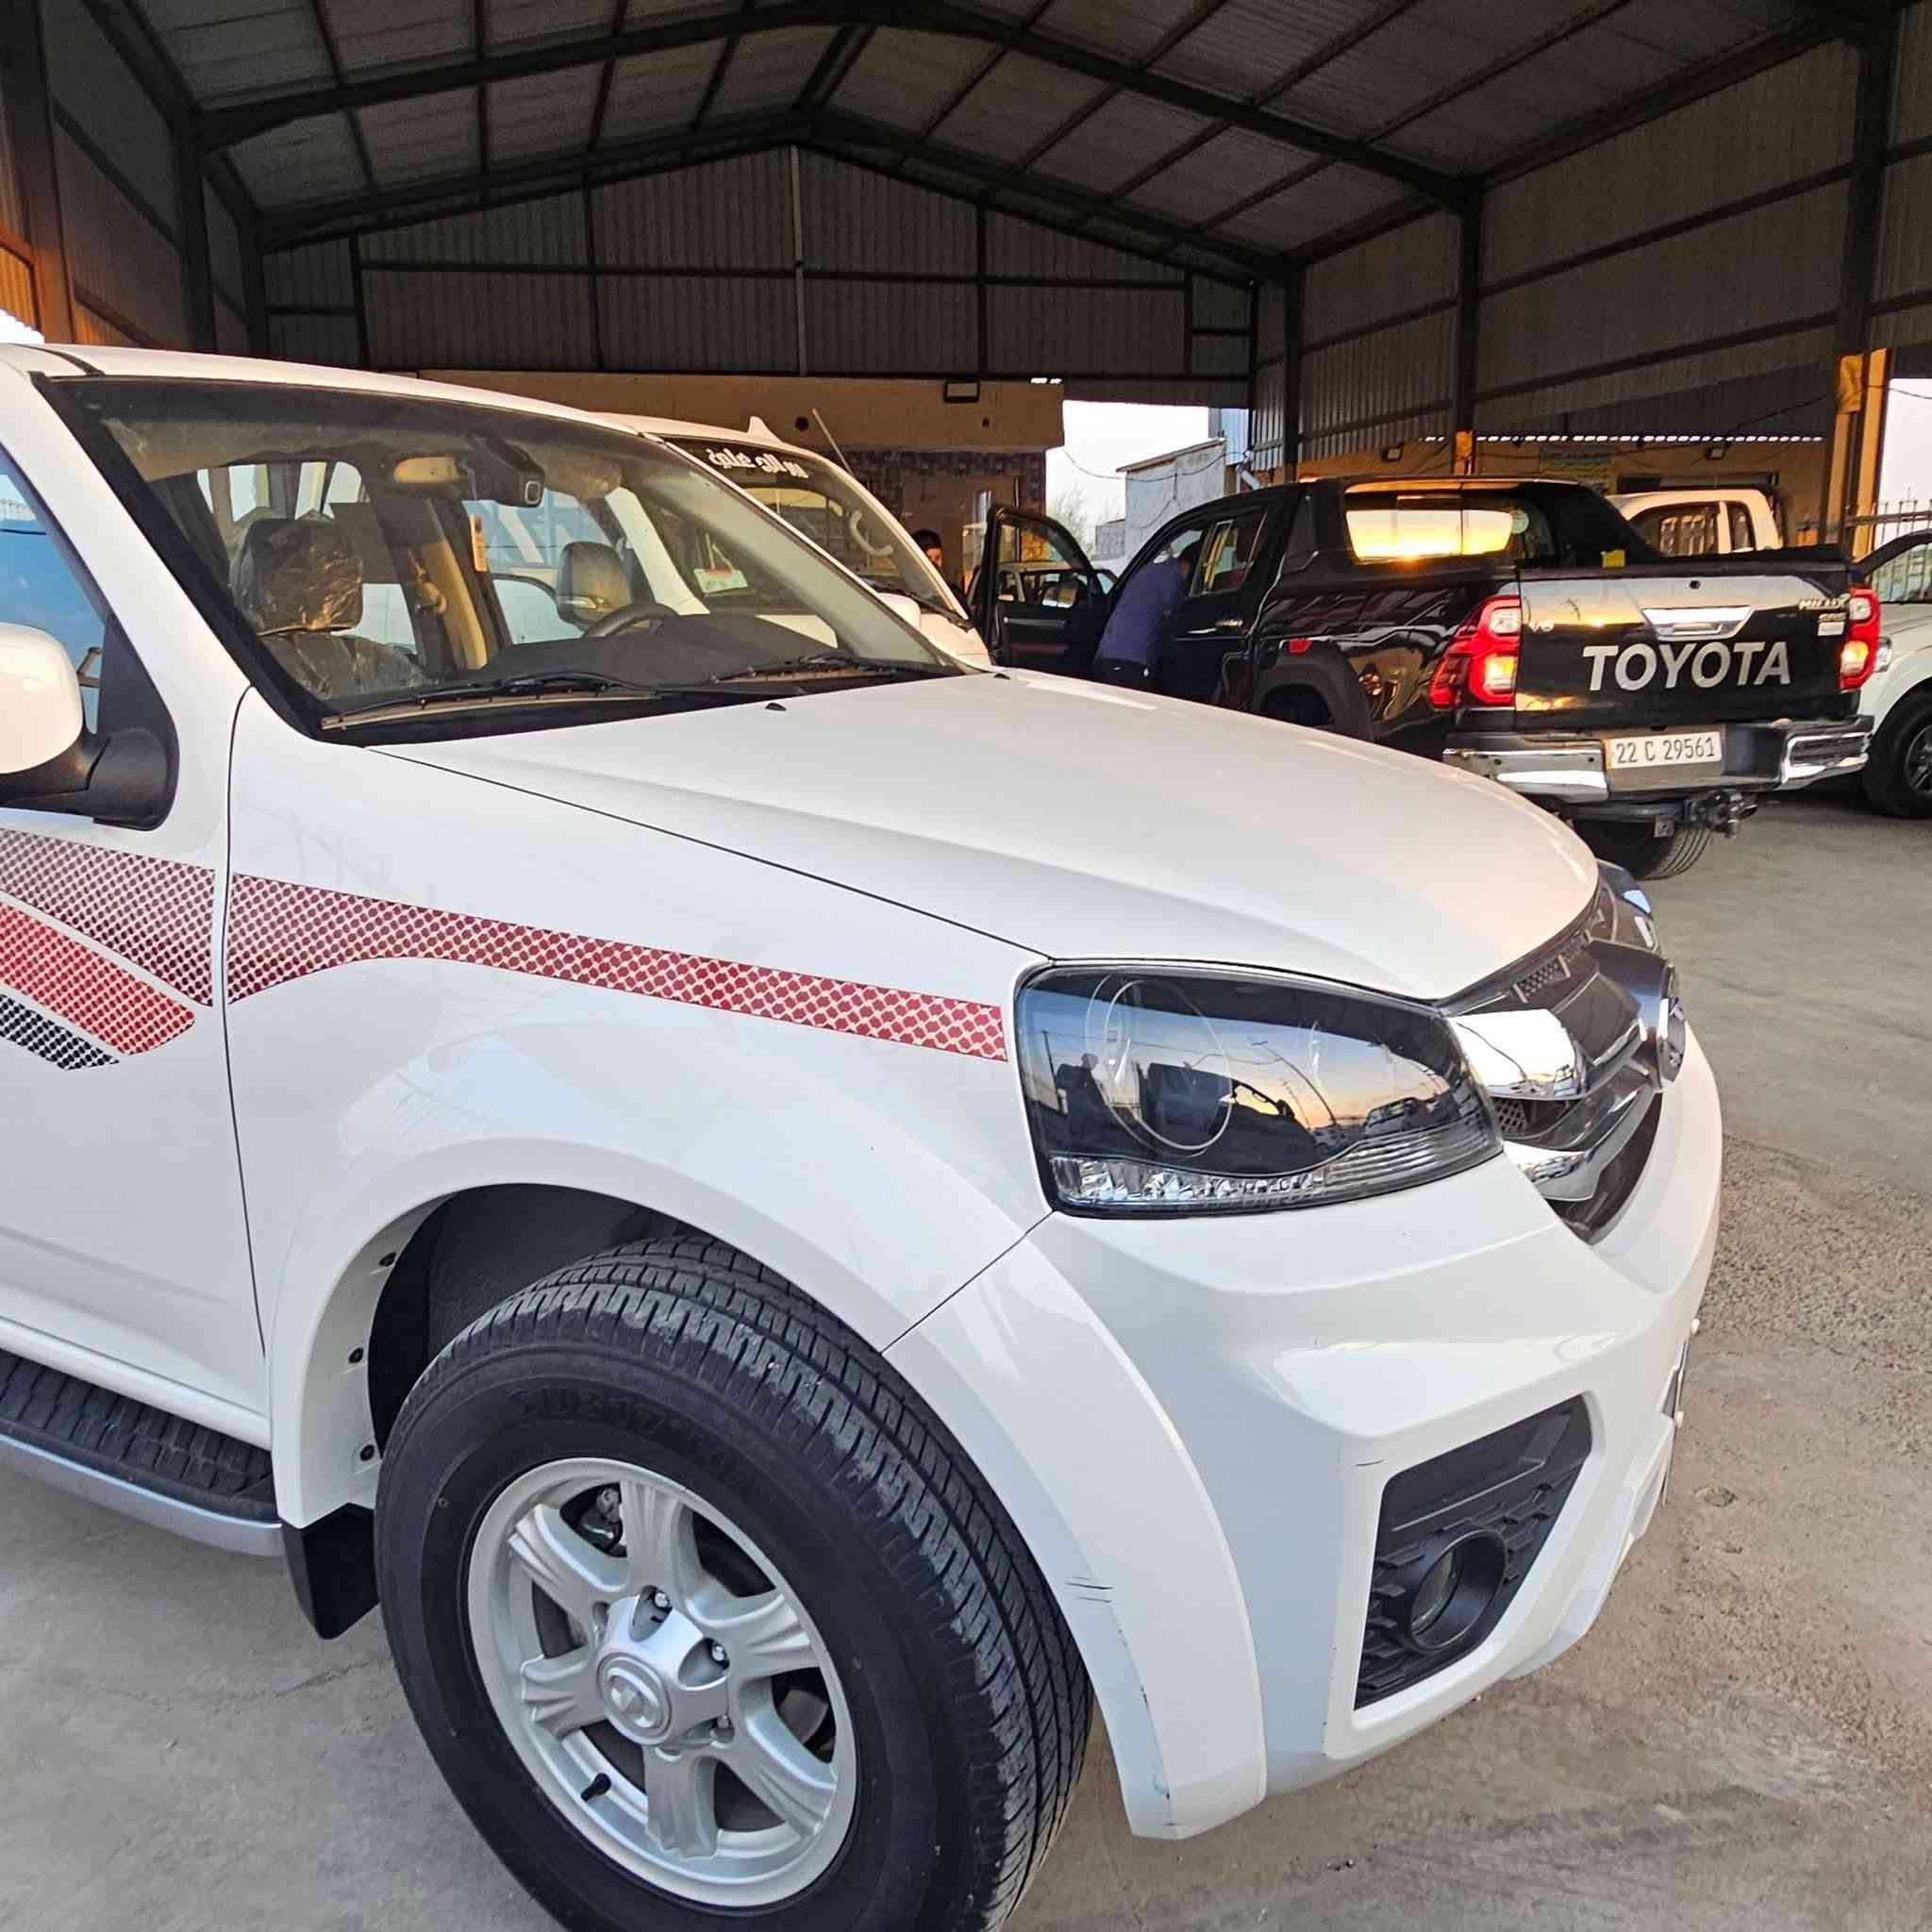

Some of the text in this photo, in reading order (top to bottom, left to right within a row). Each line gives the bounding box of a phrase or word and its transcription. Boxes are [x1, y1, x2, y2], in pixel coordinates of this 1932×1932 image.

[1583, 641, 1790, 691] TOYOTA
[1615, 737, 1715, 764] 22 C 29561
